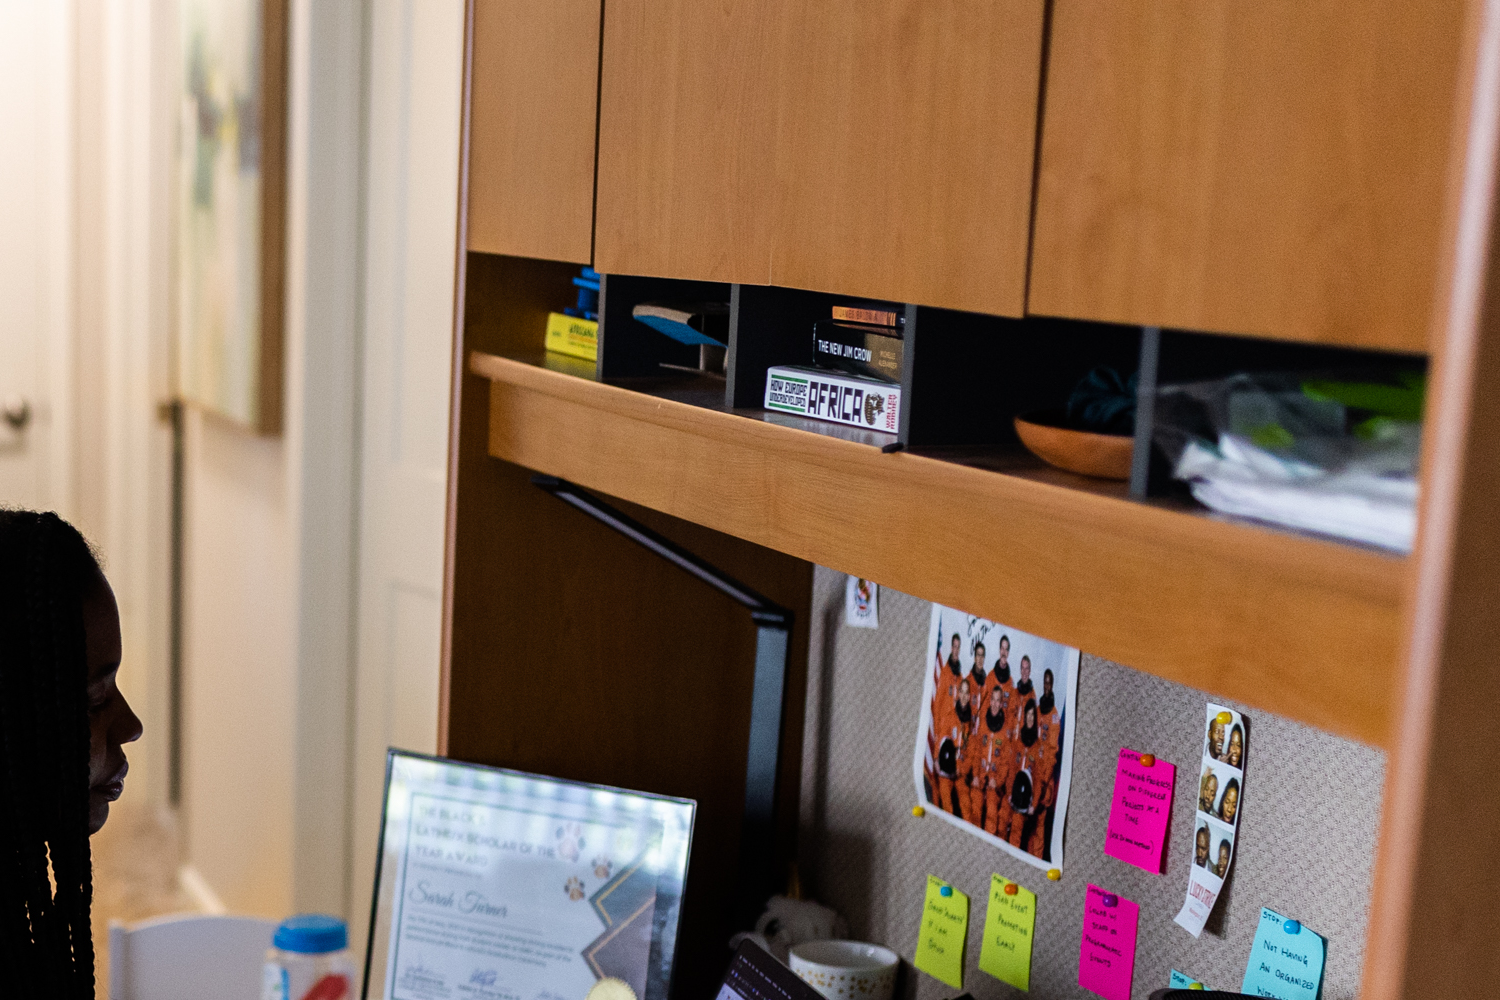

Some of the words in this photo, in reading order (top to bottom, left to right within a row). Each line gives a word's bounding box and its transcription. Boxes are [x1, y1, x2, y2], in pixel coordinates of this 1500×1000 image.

[818, 339, 829, 353] THE
[829, 341, 843, 356] NEW
[843, 344, 853, 359] JIM
[853, 347, 872, 362] CROW
[769, 392, 806, 407] UNDERDEVELOPED
[770, 380, 784, 392] HOW
[784, 382, 808, 396] EUROPE
[807, 381, 864, 423] AFRICA
[885, 394, 893, 429] WALTER
[890, 394, 898, 430] RODNEY
[1124, 813, 1139, 826] TIME
[408, 878, 455, 908] Sarah
[457, 889, 508, 918] Turner
[1262, 911, 1283, 926] STOP:
[1263, 939, 1278, 952] NOT
[1281, 947, 1309, 968] HAVING
[1259, 962, 1271, 973] AN
[1274, 968, 1315, 990] ORGANIZED
